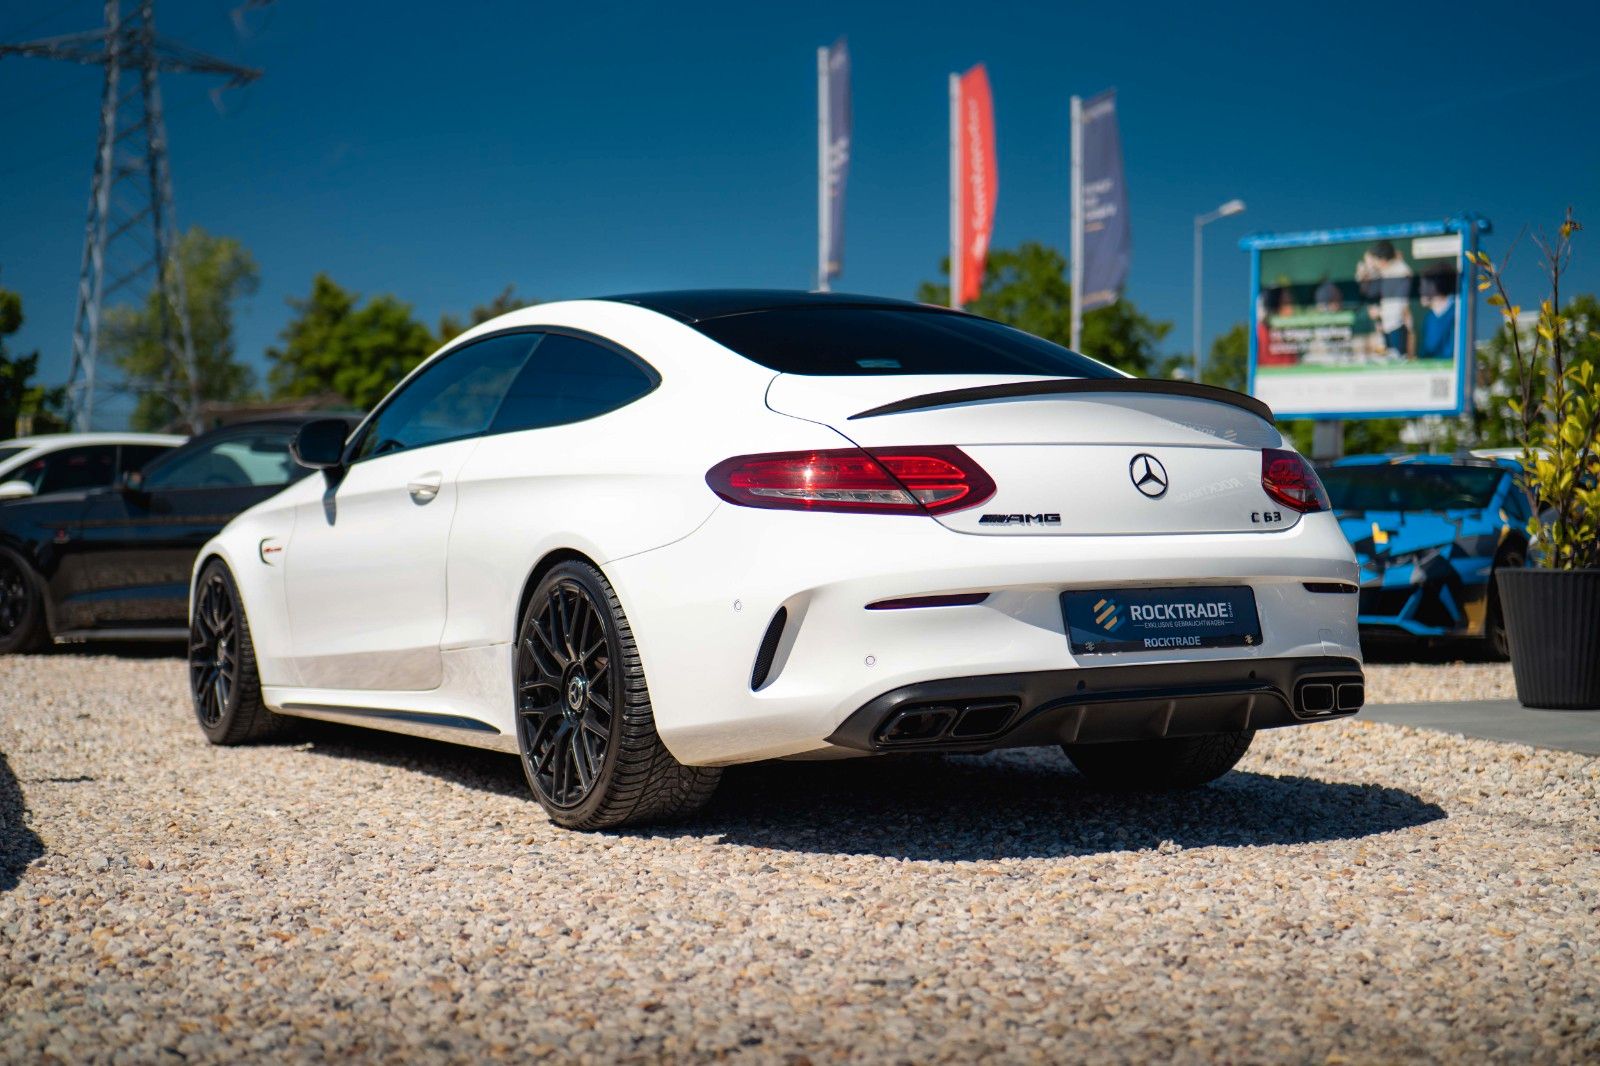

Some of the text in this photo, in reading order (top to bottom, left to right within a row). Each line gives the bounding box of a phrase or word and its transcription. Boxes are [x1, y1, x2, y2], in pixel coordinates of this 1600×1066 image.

[1251, 511, 1282, 523] C 63
[1130, 602, 1228, 621] ROCKTRADE
[1144, 620, 1174, 629] EXKLUSIVE
[1143, 636, 1202, 648] ROCKTRADE
